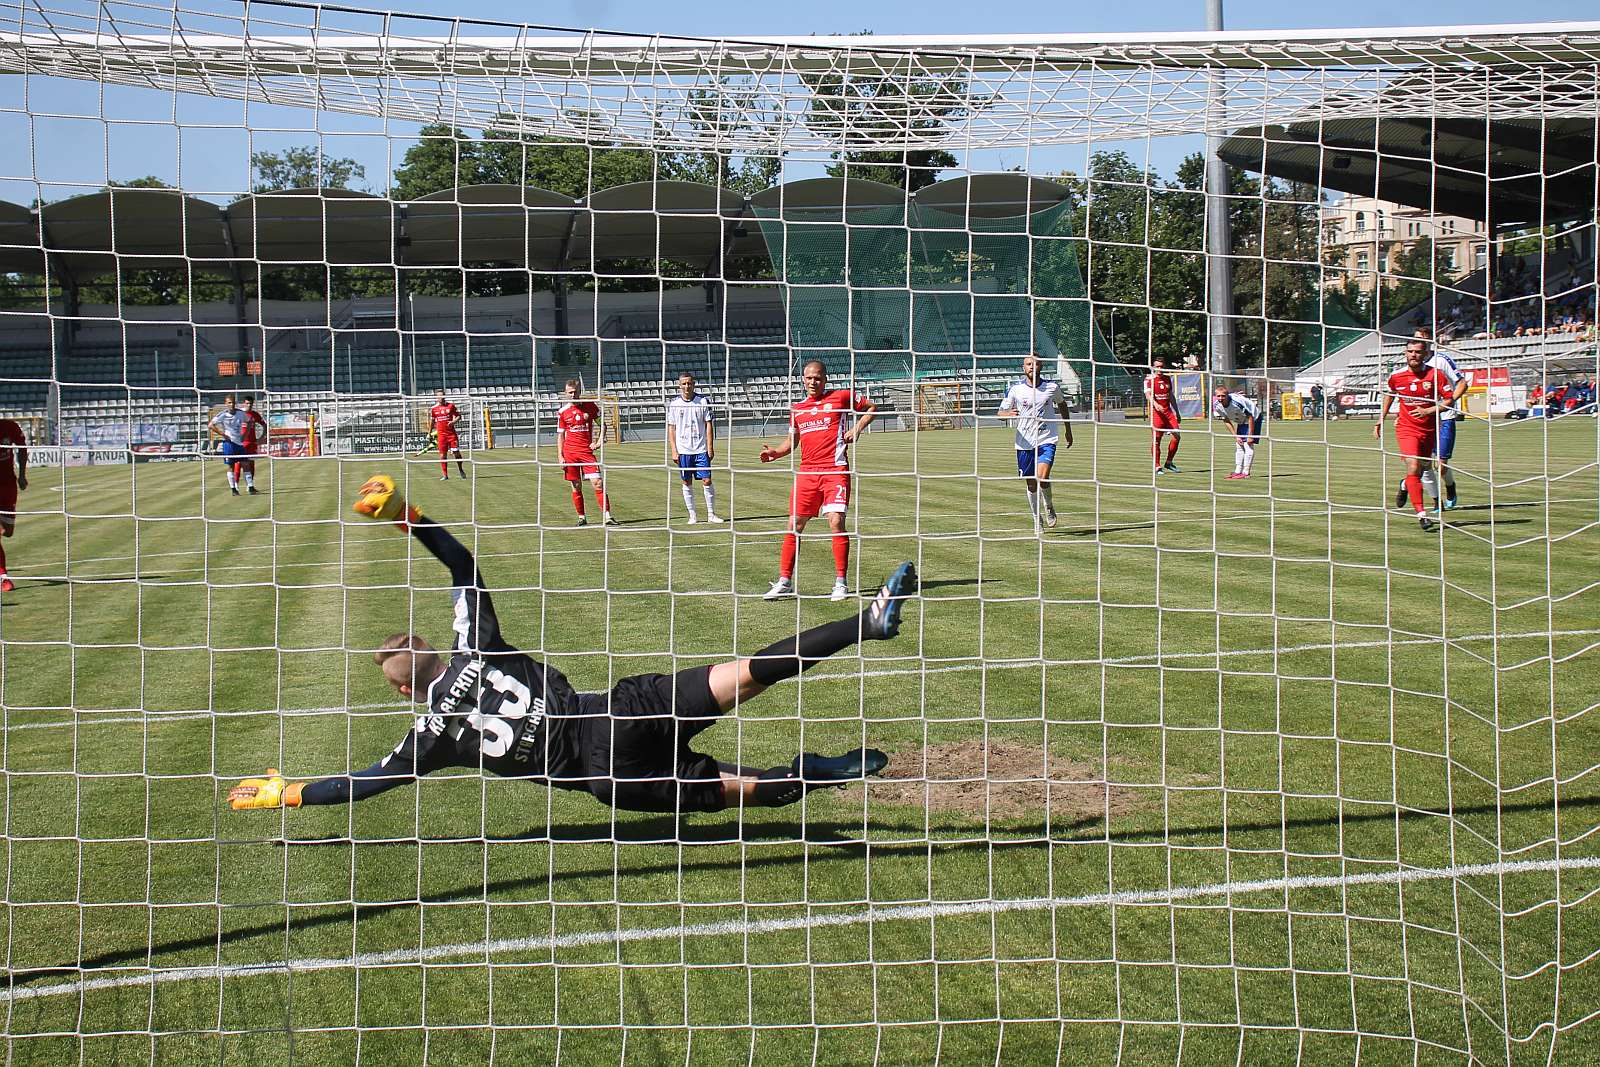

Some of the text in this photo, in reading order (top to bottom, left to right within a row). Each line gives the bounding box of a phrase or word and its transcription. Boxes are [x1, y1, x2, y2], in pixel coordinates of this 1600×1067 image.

[363, 443, 424, 453] www.piast.nfo.pl
[88, 450, 126, 461] PANDA
[447, 666, 531, 758] 33
